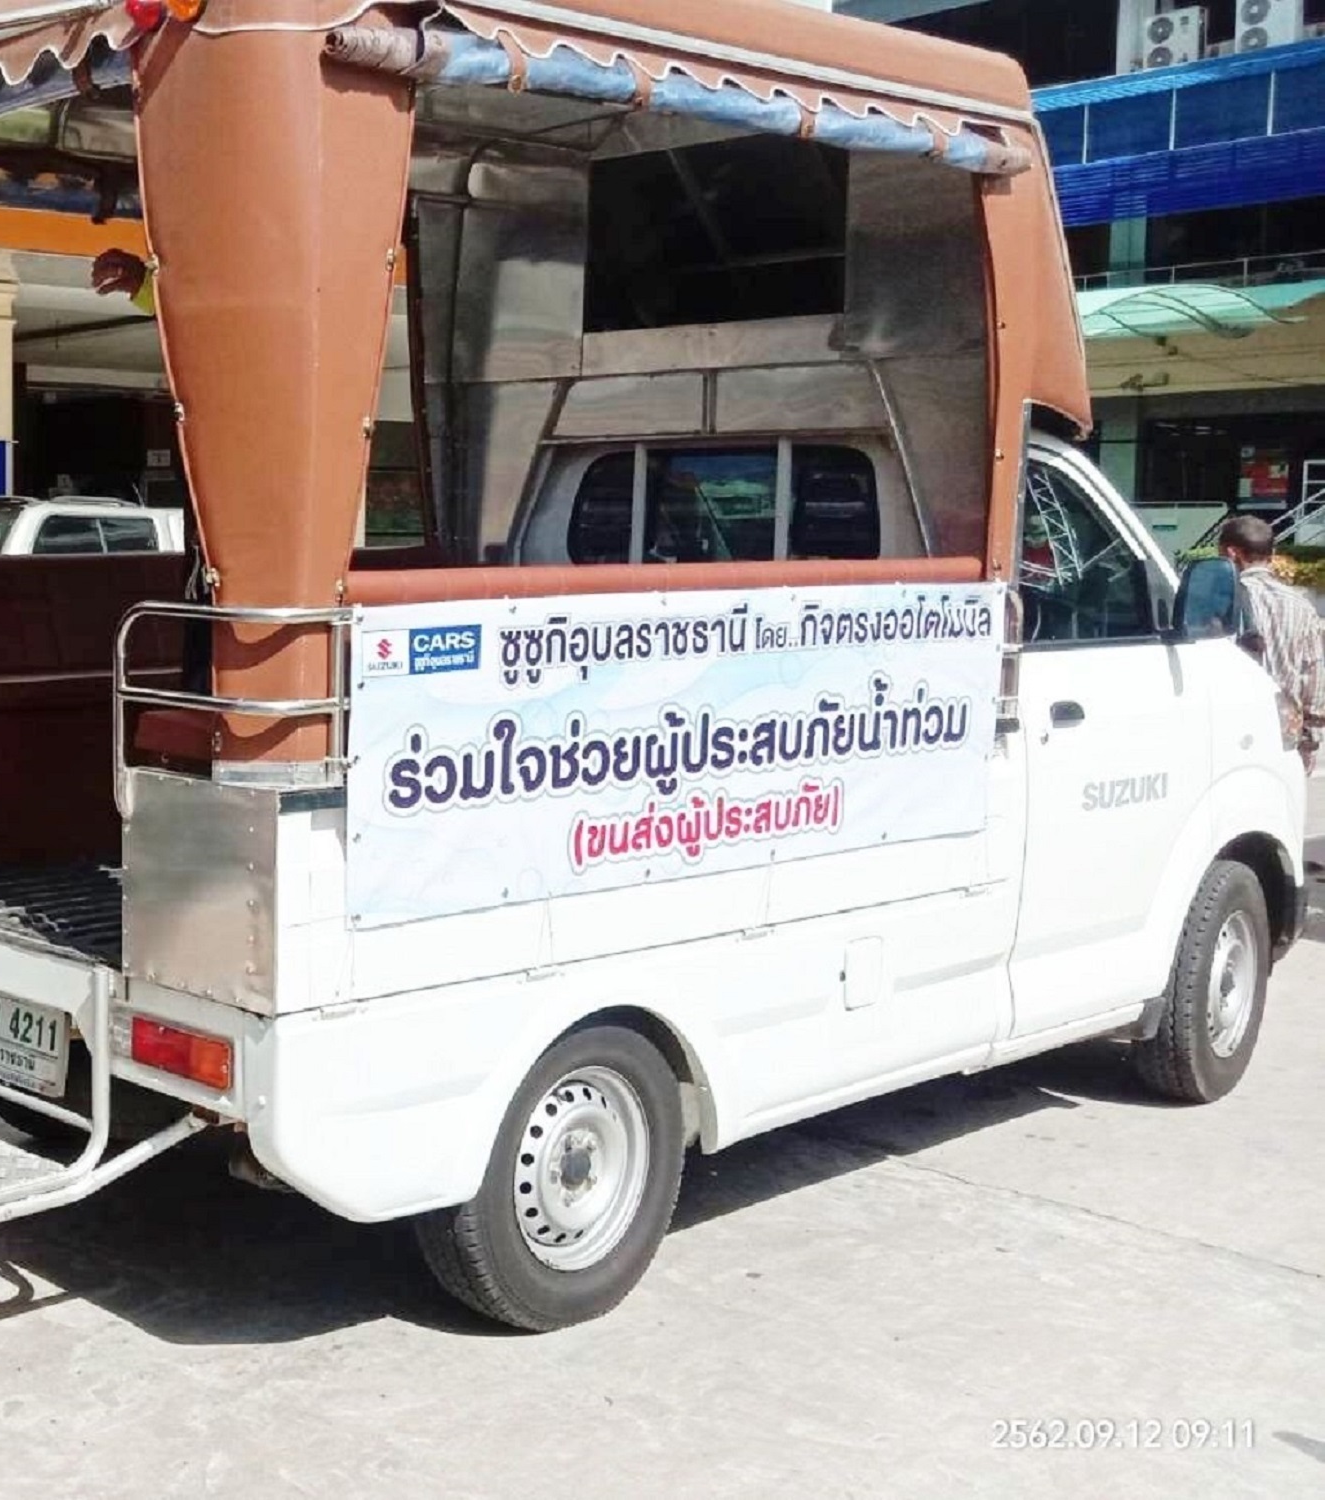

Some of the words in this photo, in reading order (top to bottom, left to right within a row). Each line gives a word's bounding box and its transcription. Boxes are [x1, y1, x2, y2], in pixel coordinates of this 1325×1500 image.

[414, 631, 475, 652] CARS
[500, 603, 748, 685] ซูซูกิอุบลราชธานี
[389, 678, 967, 808] ร่วมใจช่วยผู้ประสบภัยน้ำท่วม
[1081, 772, 1168, 811] SUZUKI
[574, 783, 840, 866] (ขนส่งผู้ประสบภัย)
[9, 1007, 57, 1051] 4211
